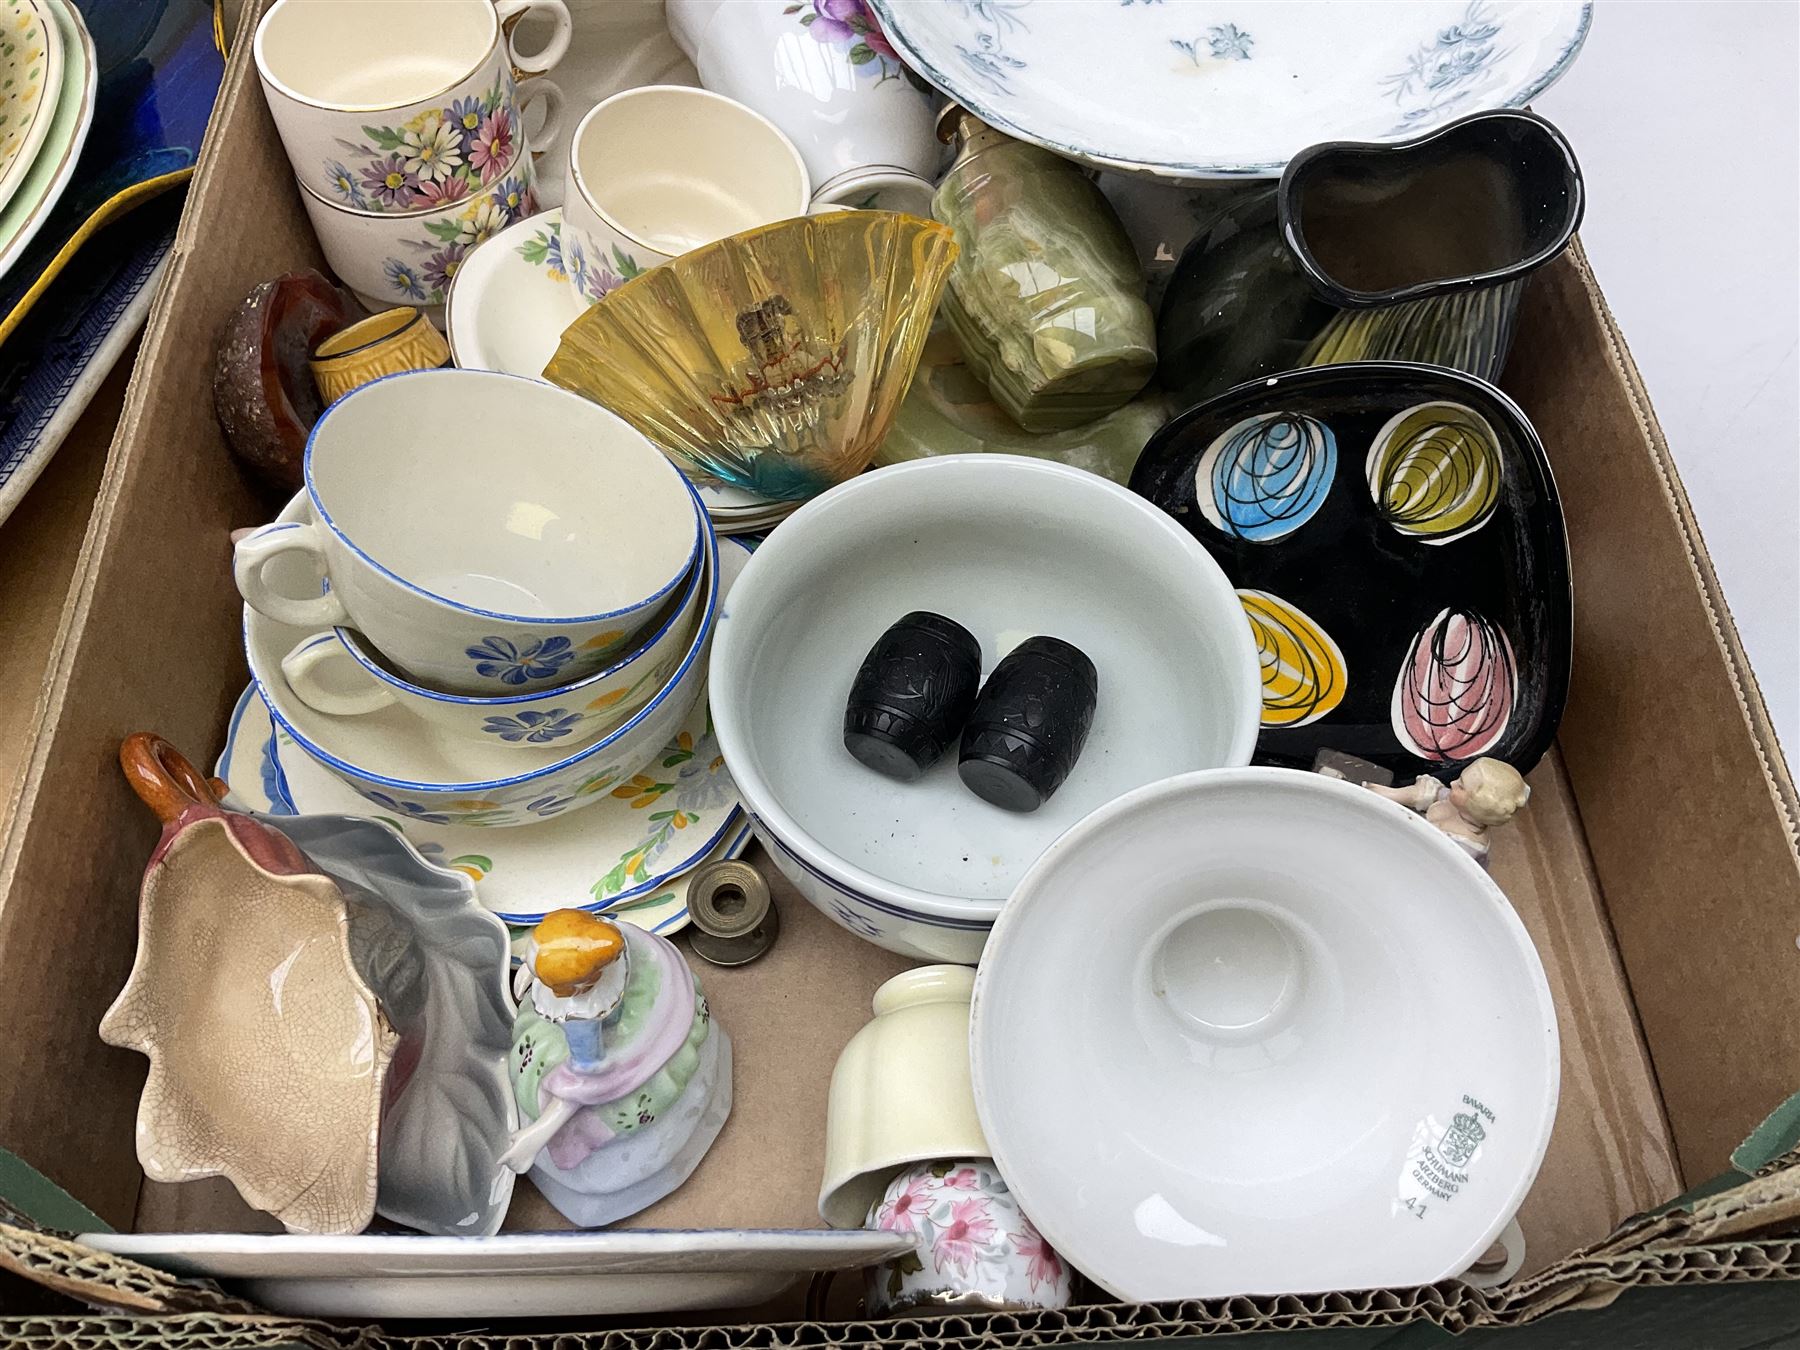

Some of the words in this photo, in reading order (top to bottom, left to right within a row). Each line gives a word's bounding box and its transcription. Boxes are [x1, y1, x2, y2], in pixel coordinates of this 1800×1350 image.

[1462, 1094, 1496, 1124] BAVARIA
[1416, 1160, 1459, 1193] ARZBERG
[1422, 1145, 1469, 1183] SCHUMANN
[1412, 1169, 1452, 1202] GERMANY
